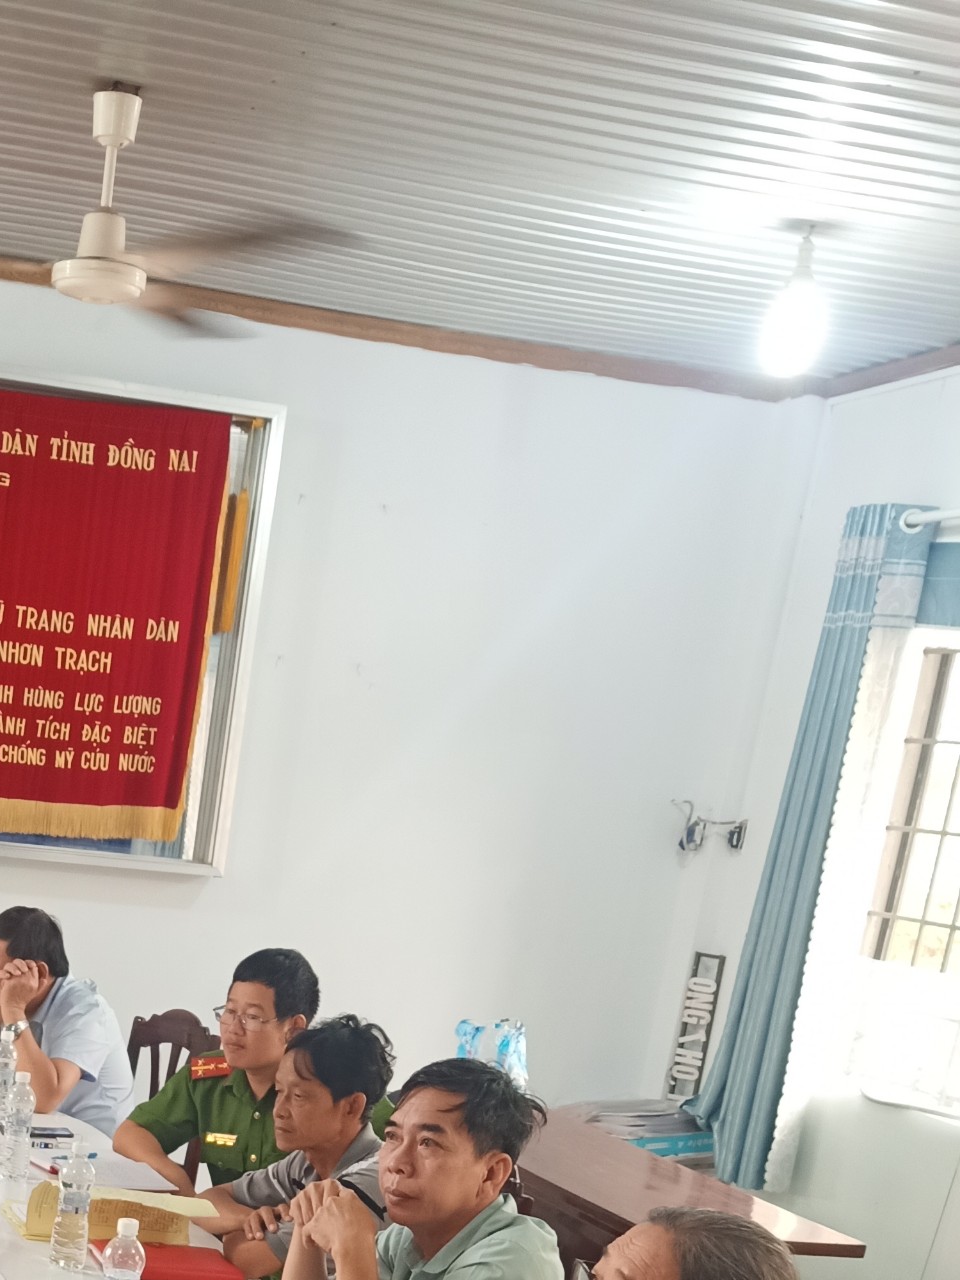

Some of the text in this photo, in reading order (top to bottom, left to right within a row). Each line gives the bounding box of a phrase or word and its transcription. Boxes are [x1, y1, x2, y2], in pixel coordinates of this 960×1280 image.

[0, 428, 38, 457] DÂN
[107, 438, 156, 471] ĐỒNG
[168, 449, 198, 473] NAI
[16, 605, 74, 634] TRANG
[87, 614, 134, 640] NHÂN
[146, 617, 179, 643] DÂN
[55, 647, 112, 675] TRẠCH
[23, 686, 64, 709] HÙNG
[74, 692, 104, 715] LỰC
[113, 695, 162, 717] LƯỢNG
[36, 716, 70, 741] TÍCH
[82, 721, 111, 746] ĐẶC
[123, 723, 157, 749] BIỆT
[0, 740, 46, 766] CHỐNG
[55, 747, 74, 769] MỸ
[81, 748, 110, 771] CỨU
[118, 751, 155, 773] NƯỚC
